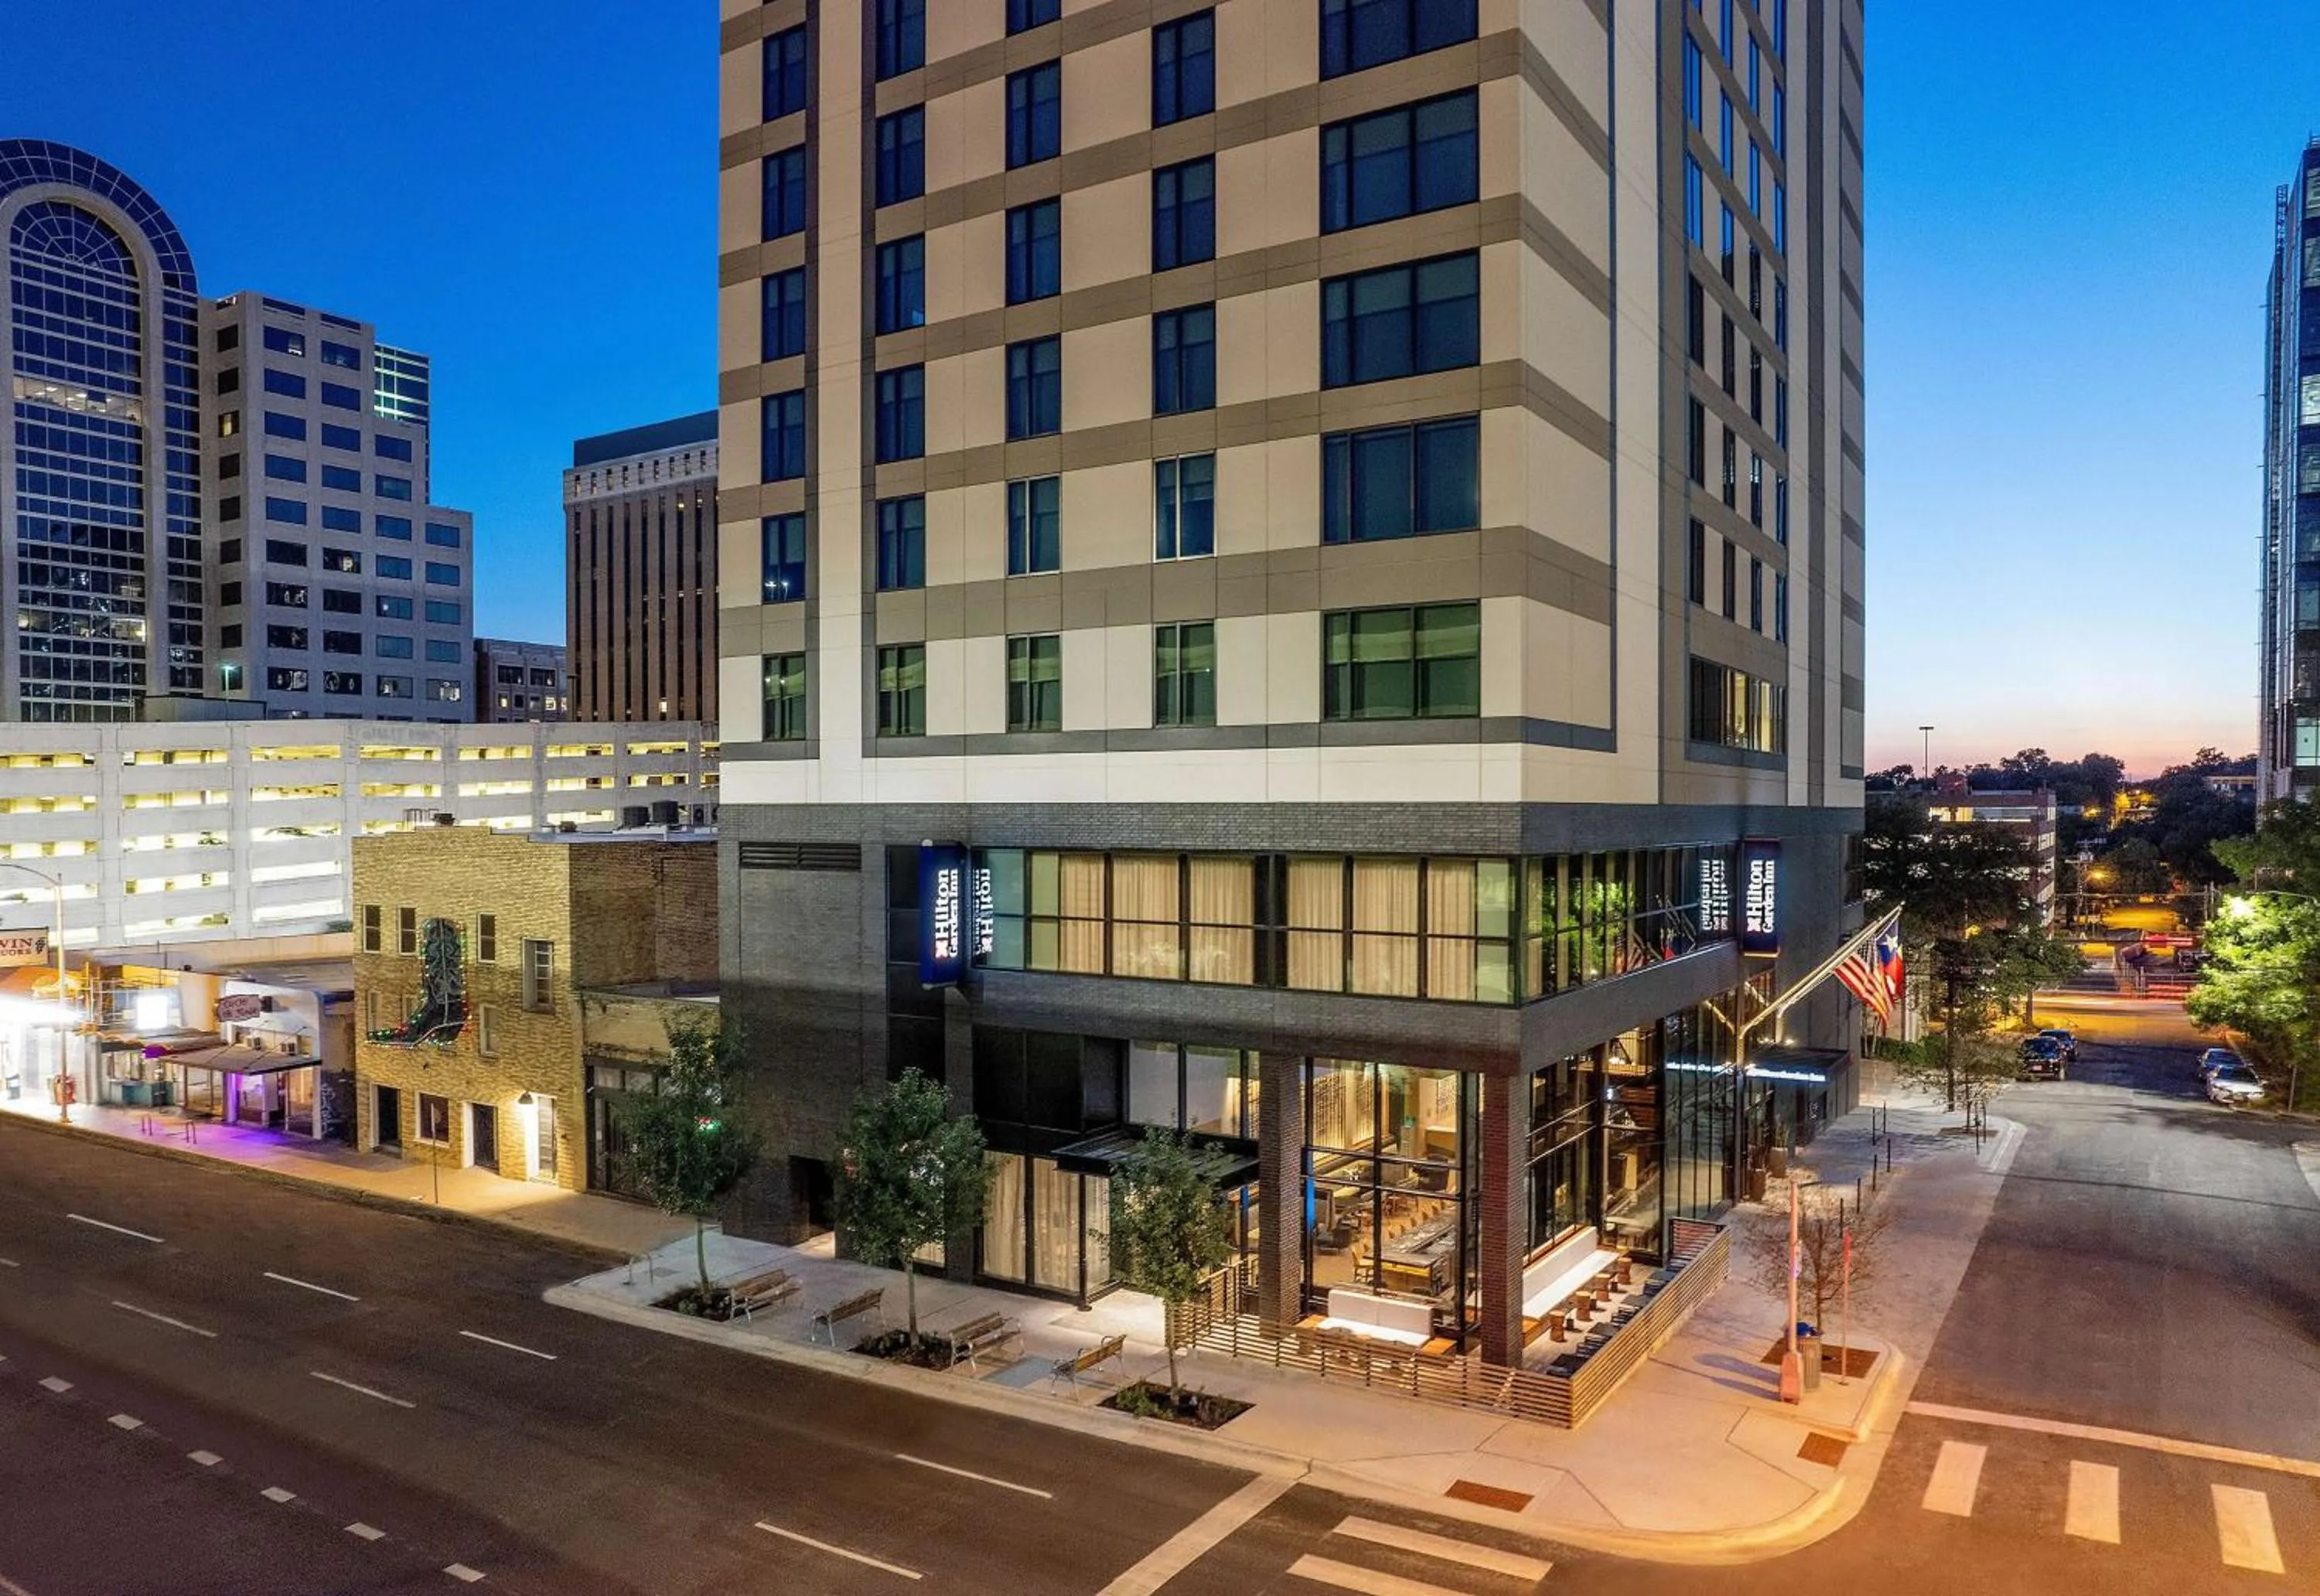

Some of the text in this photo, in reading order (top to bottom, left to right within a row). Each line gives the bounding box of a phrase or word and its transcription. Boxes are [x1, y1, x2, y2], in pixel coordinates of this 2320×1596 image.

[935, 869, 949, 940] Hilton
[949, 868, 958, 958] Garden Inn
[1746, 860, 1763, 916] Hilton
[1763, 860, 1775, 933] Garden Inn
